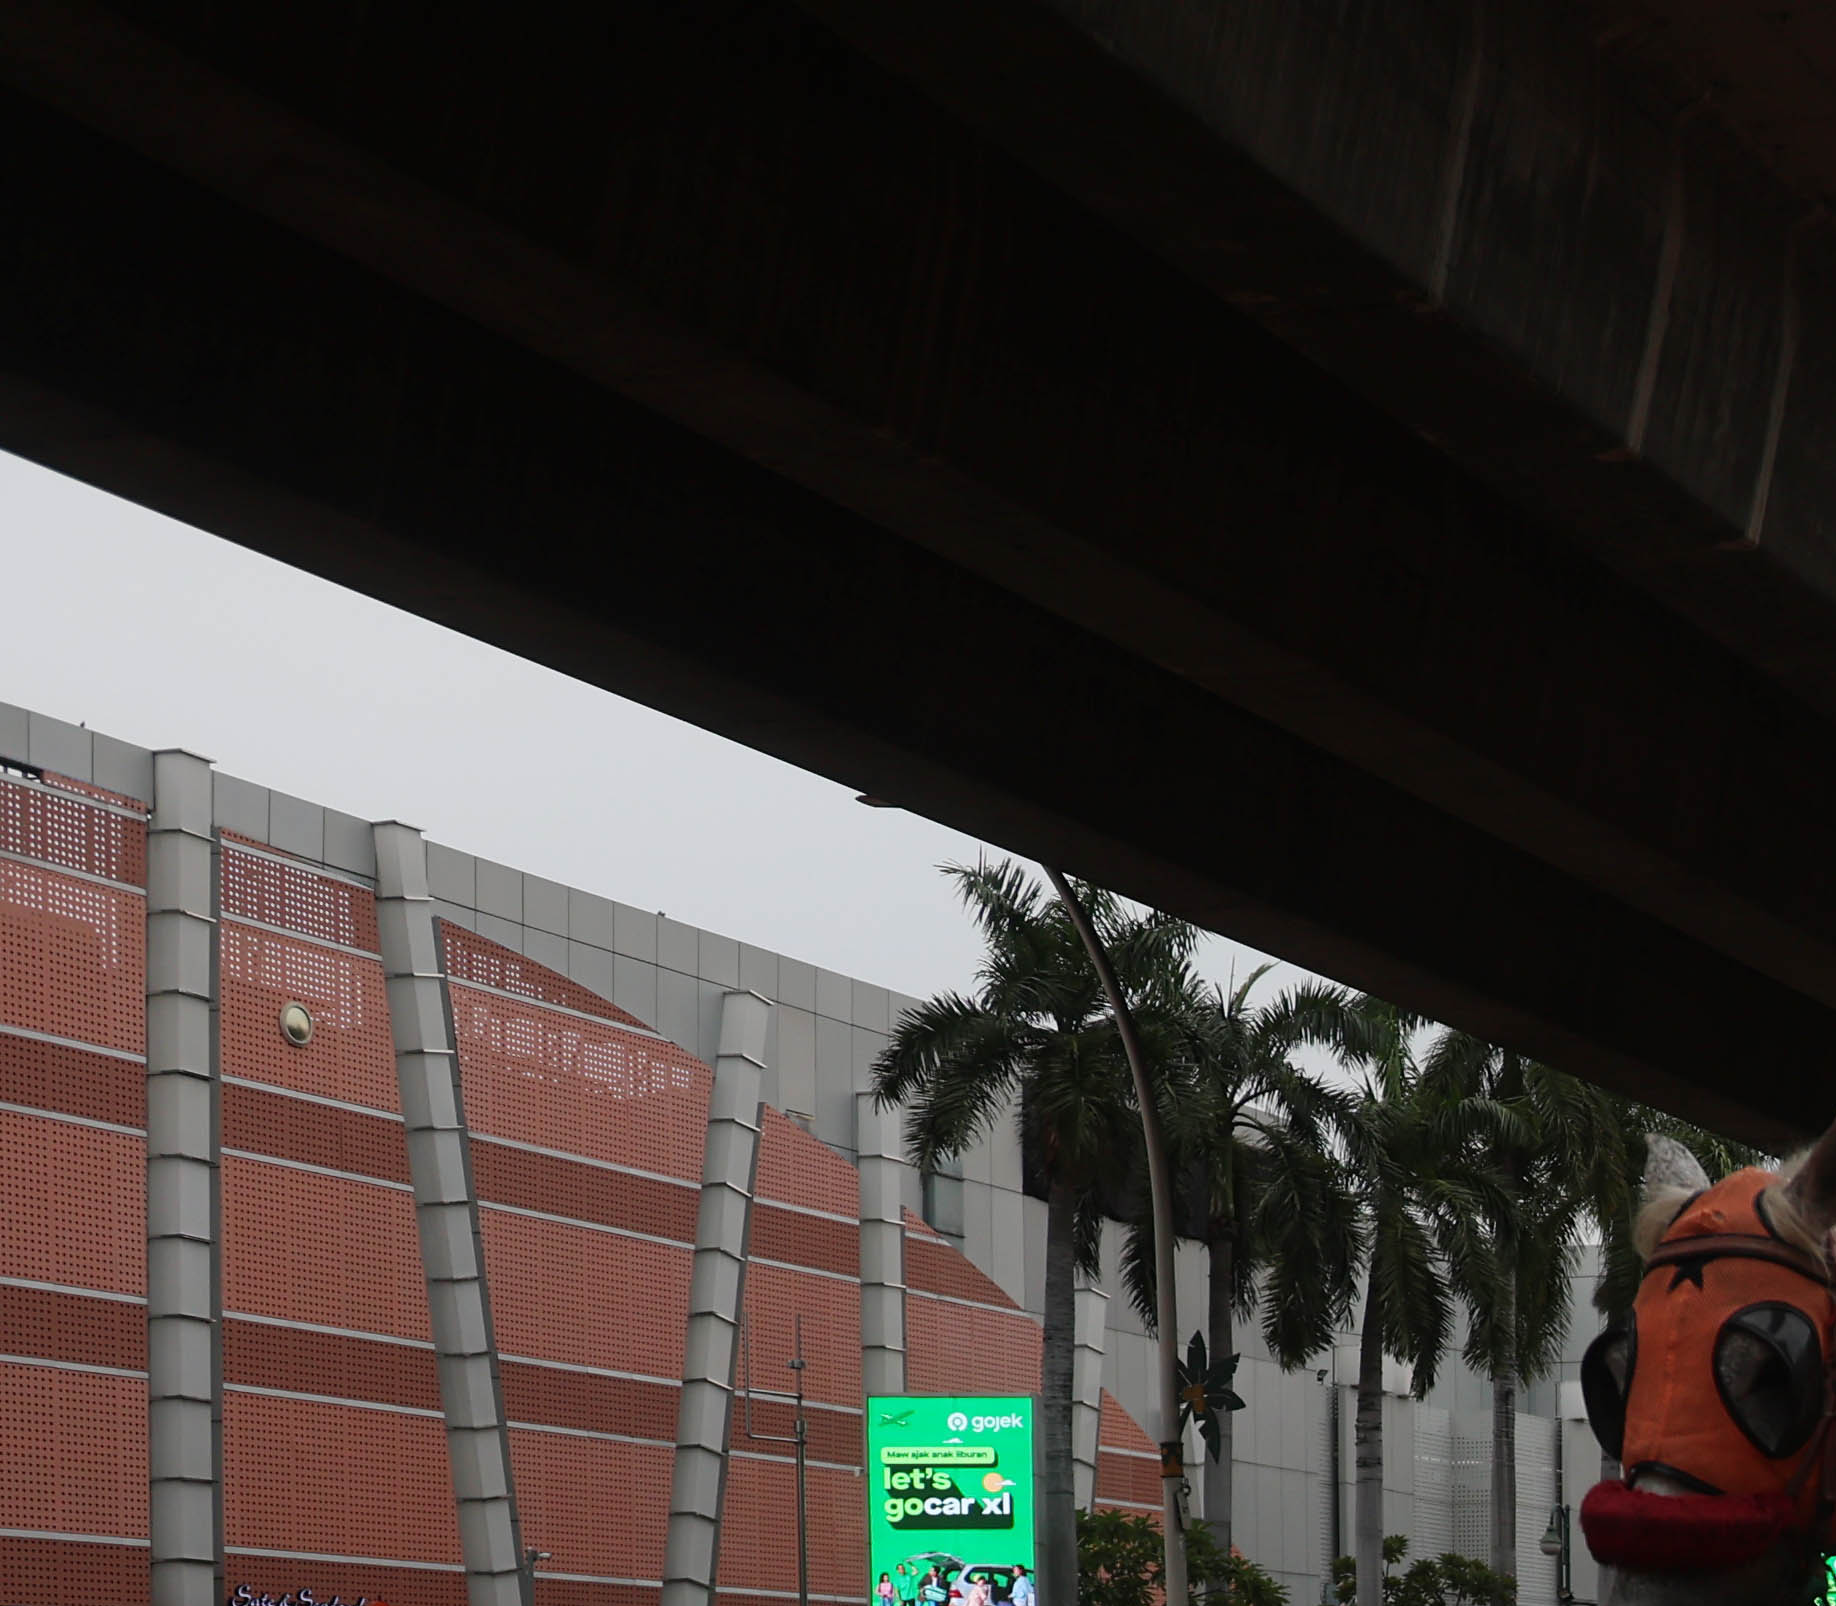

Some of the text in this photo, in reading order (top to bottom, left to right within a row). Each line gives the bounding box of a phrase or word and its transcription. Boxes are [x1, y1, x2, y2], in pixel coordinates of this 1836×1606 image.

[971, 1412, 1024, 1432] gojek
[883, 1467, 951, 1490] let's
[883, 1492, 1011, 1523] gocar xl
